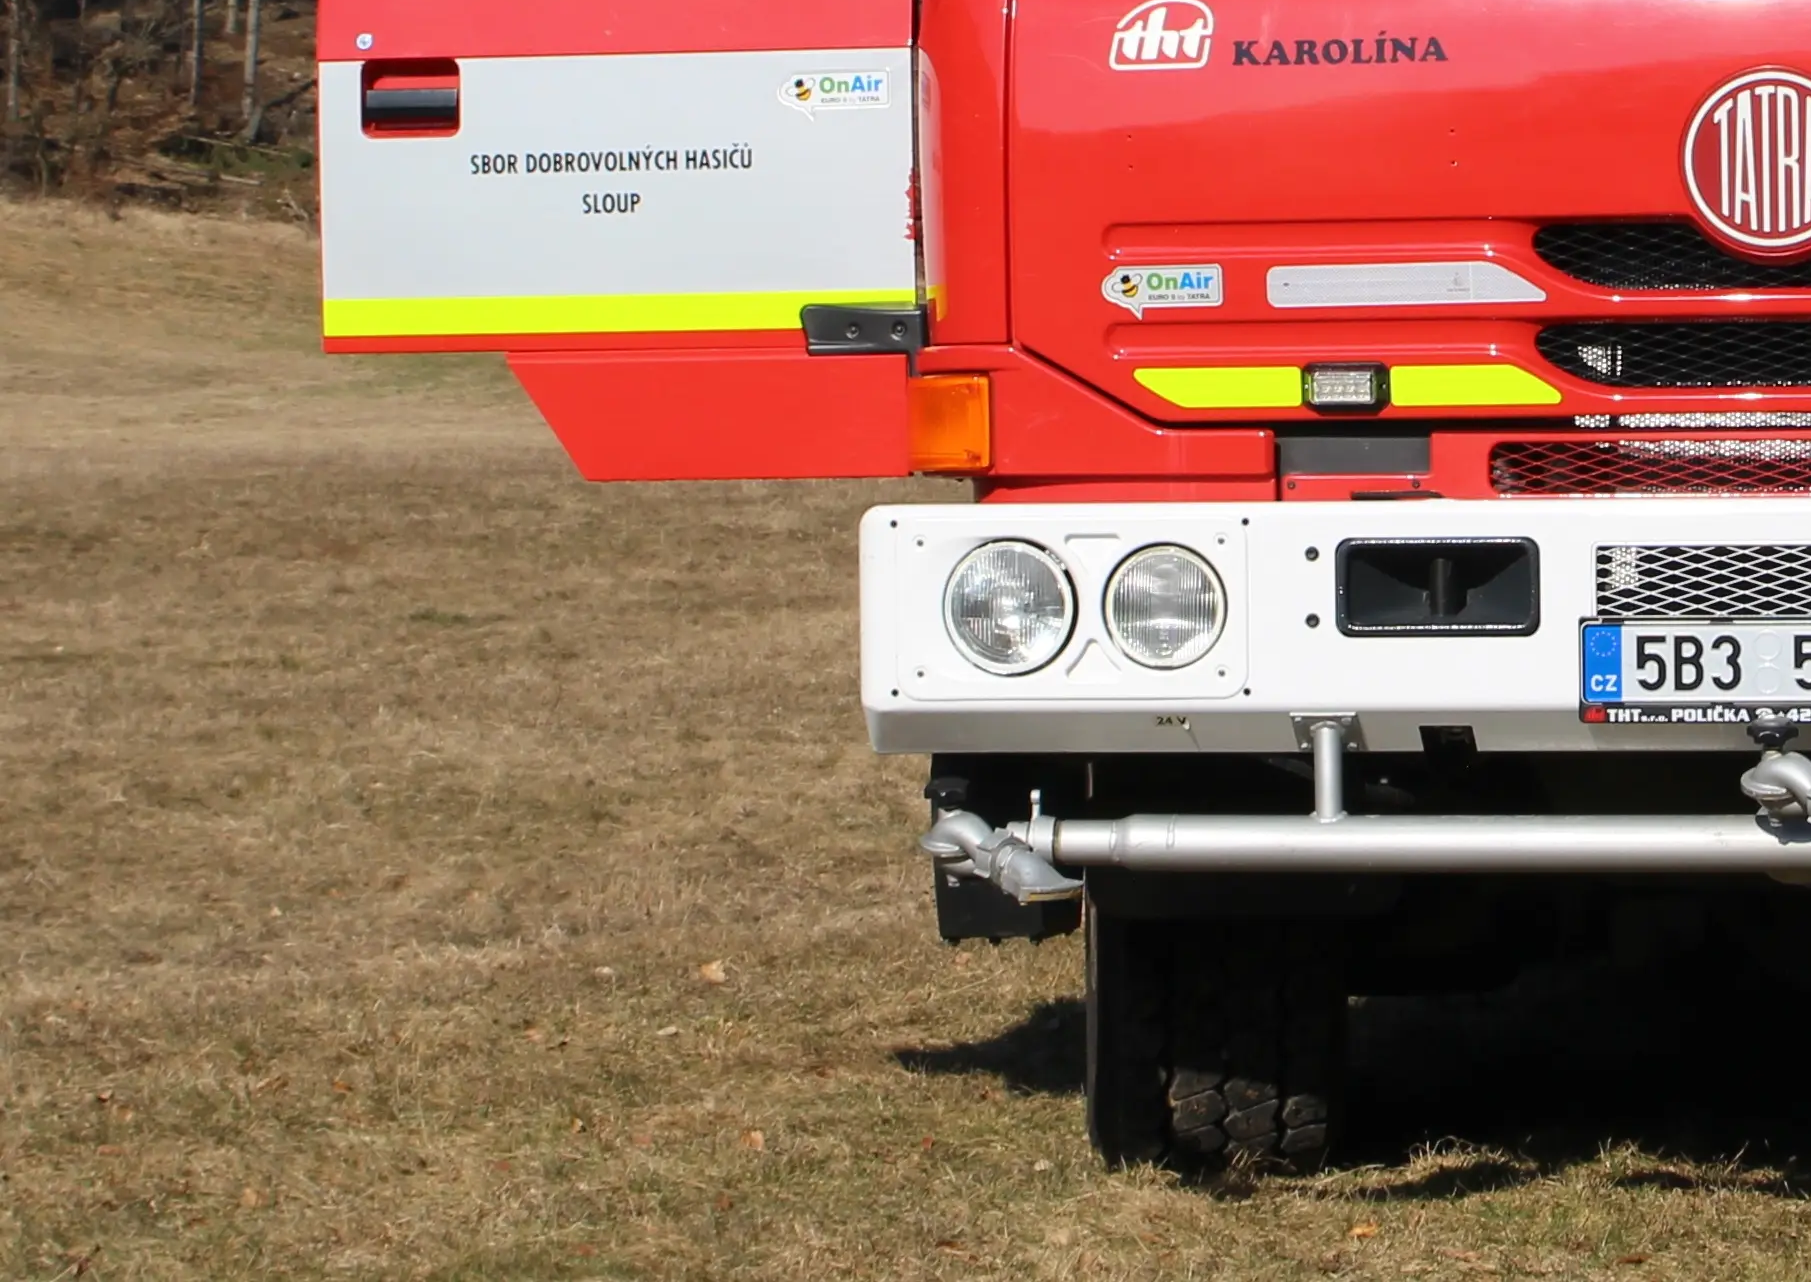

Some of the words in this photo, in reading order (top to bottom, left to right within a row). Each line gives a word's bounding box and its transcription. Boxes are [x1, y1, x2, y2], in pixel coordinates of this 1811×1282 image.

[1232, 31, 1448, 66] KAROLÍNA
[819, 75, 883, 94] OnAir
[470, 153, 518, 175] SBOR
[526, 145, 678, 174] DOBROVOLNÝCH
[685, 144, 752, 170] HASIČŮ
[582, 193, 641, 214] SLOUP
[1146, 272, 1213, 291] OnAir
[1636, 635, 1742, 691] 5B3
[1590, 675, 1617, 692] CZ
[1176, 716, 1187, 725] V
[1671, 705, 1750, 723] POLIČKA
